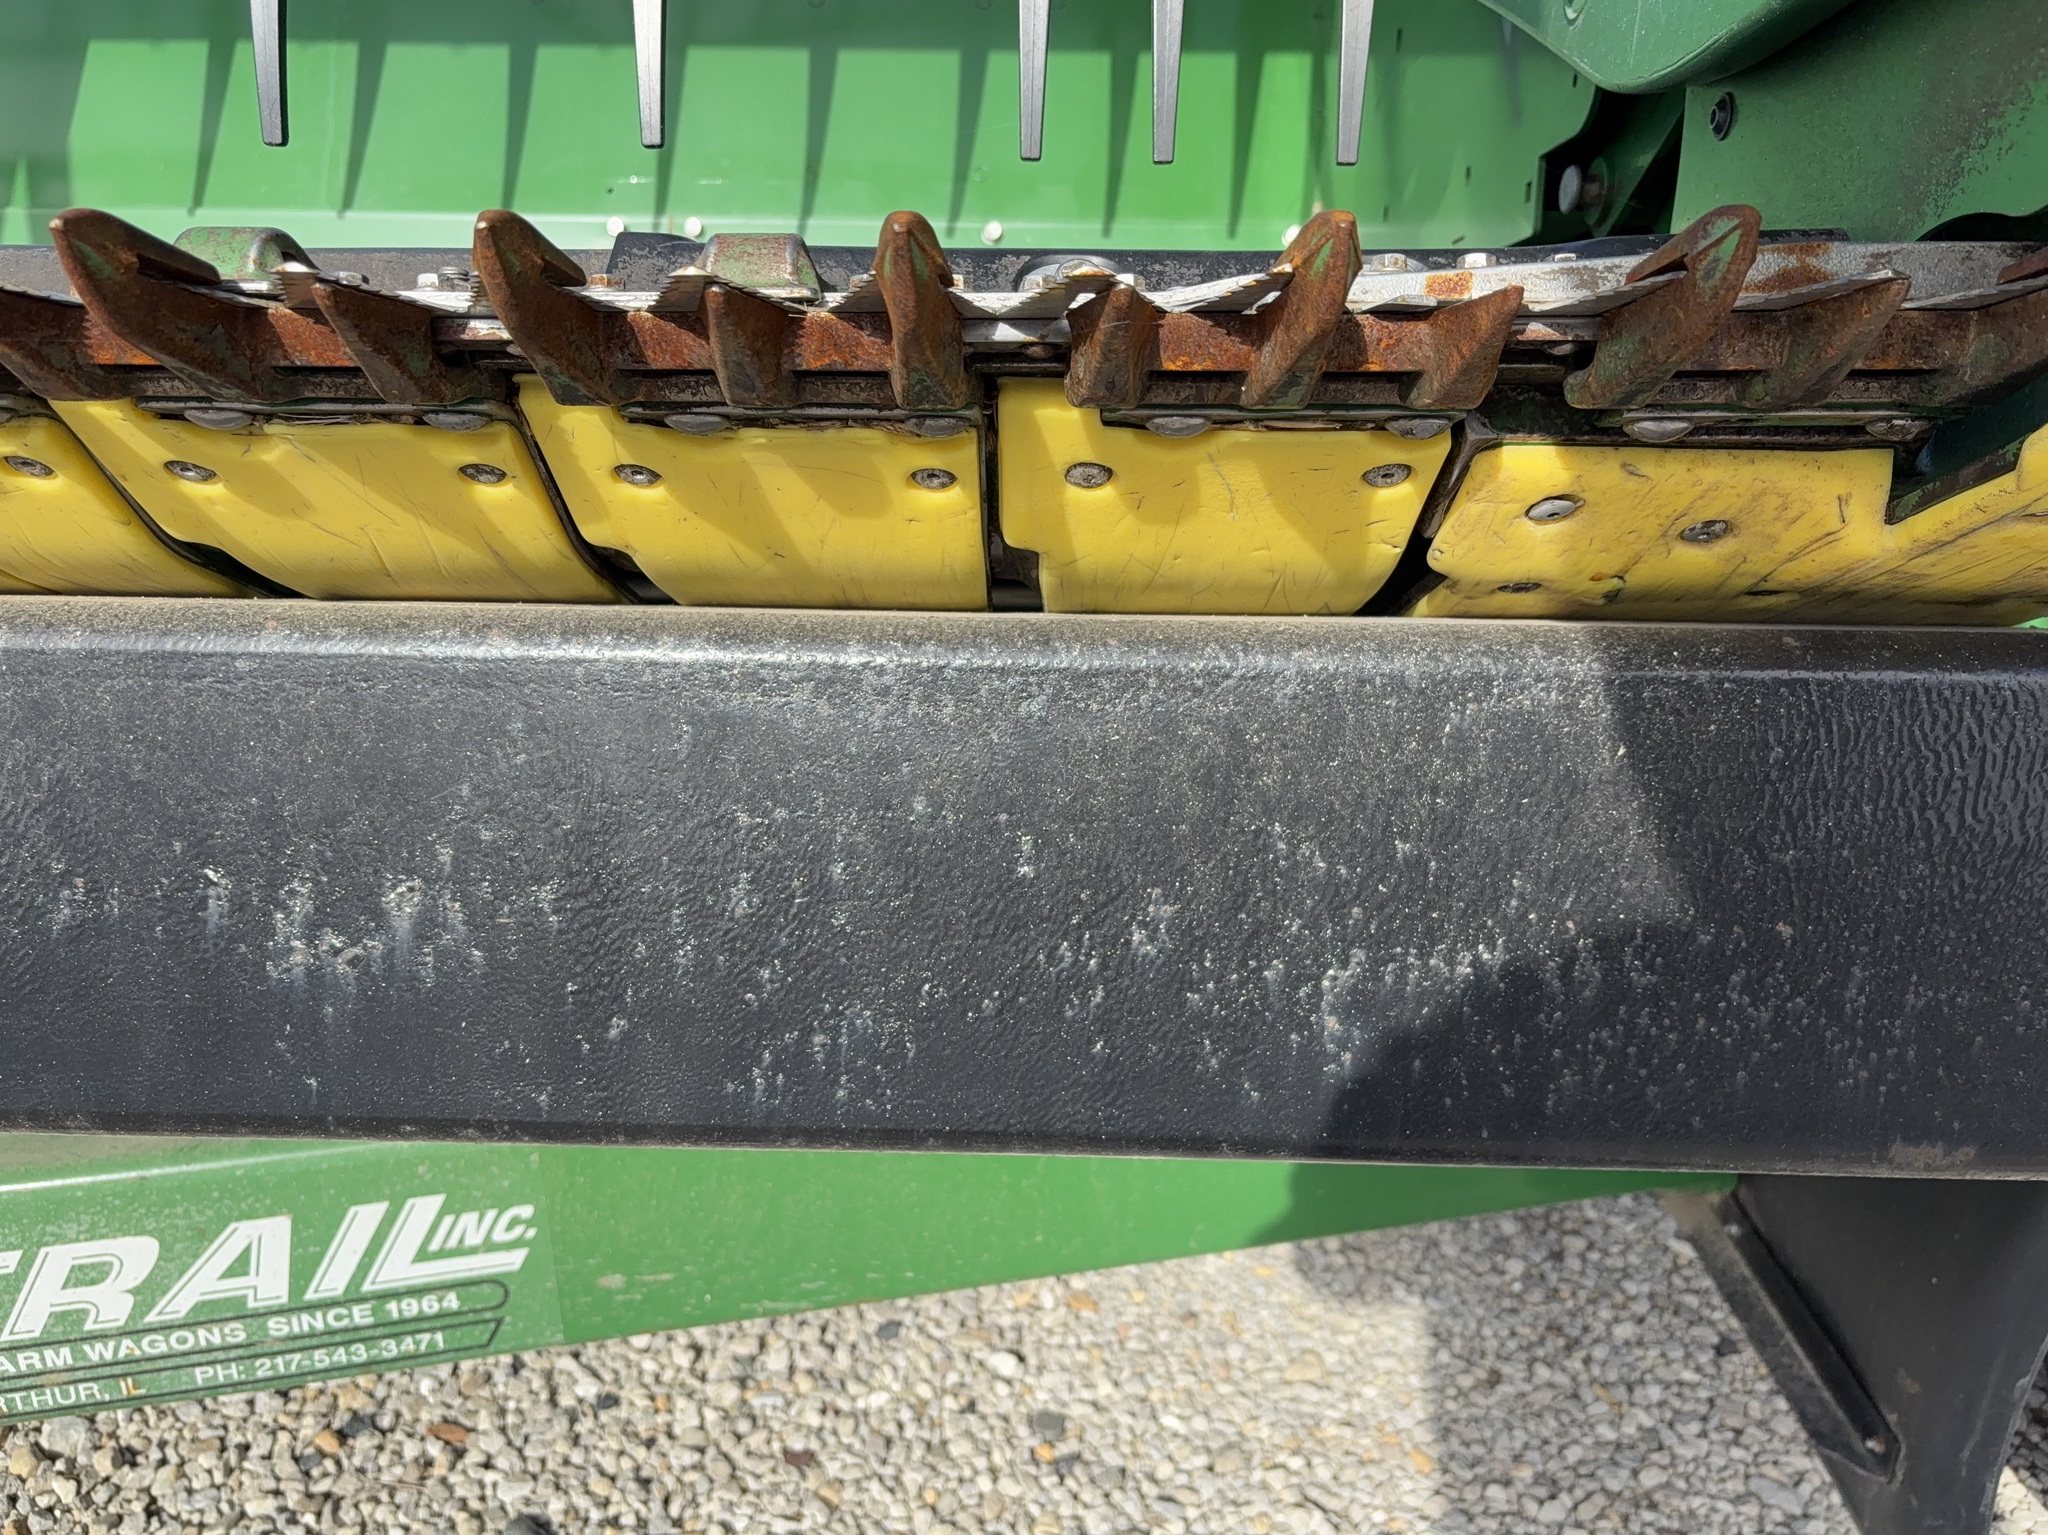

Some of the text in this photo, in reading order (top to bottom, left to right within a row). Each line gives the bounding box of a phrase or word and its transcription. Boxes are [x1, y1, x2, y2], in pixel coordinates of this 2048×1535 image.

[0, 1193, 538, 1341] RAIL INC.
[82, 1322, 247, 1362] WAGONS
[267, 1302, 375, 1337] SINCE
[384, 1291, 461, 1321] 1964
[118, 1376, 147, 1397] IL
[194, 1362, 246, 1386] PH:
[255, 1330, 445, 1379] 217-543-3471
